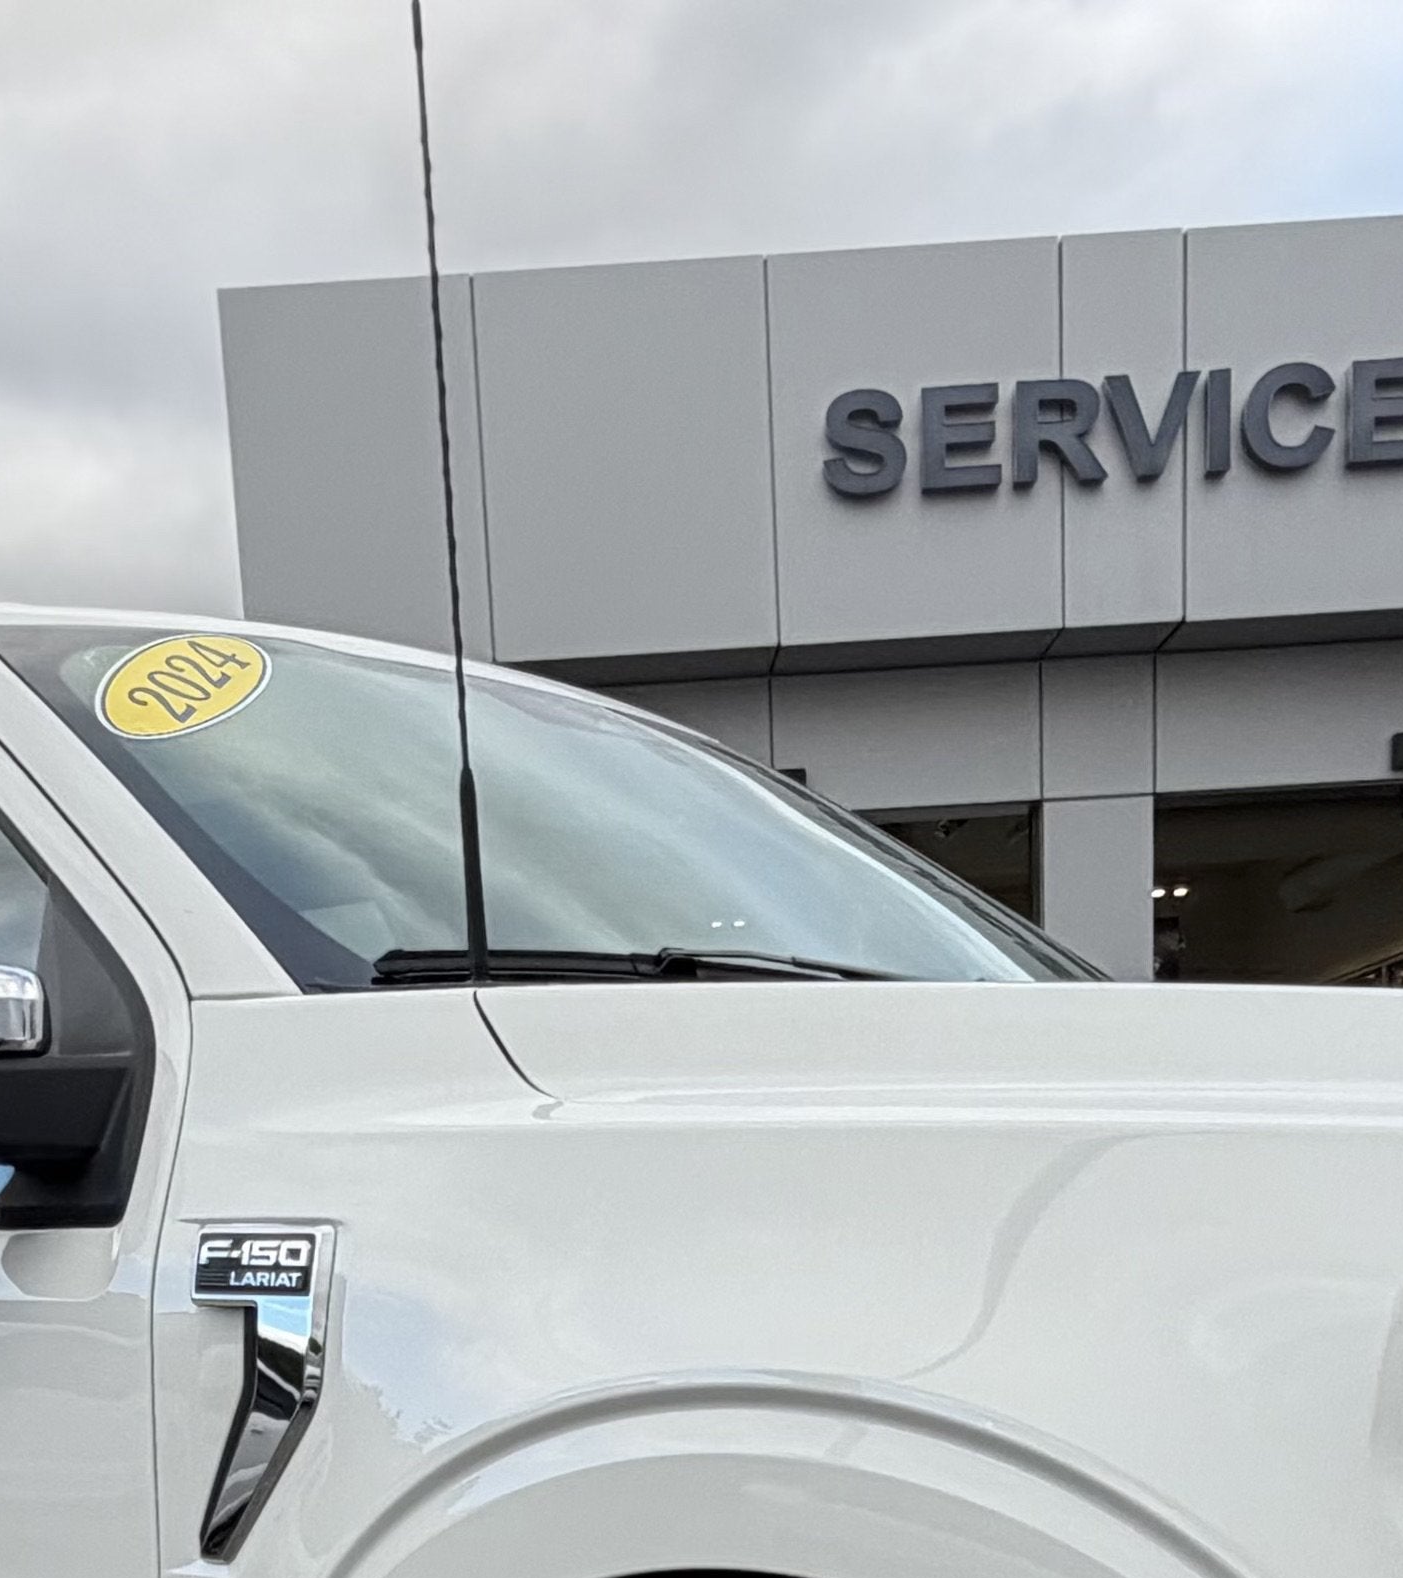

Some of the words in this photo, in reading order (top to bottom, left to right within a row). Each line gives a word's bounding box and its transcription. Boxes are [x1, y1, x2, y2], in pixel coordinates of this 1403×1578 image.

[128, 640, 251, 724] 2024
[199, 1239, 312, 1267] F-150
[229, 1271, 302, 1288] LARIAT
